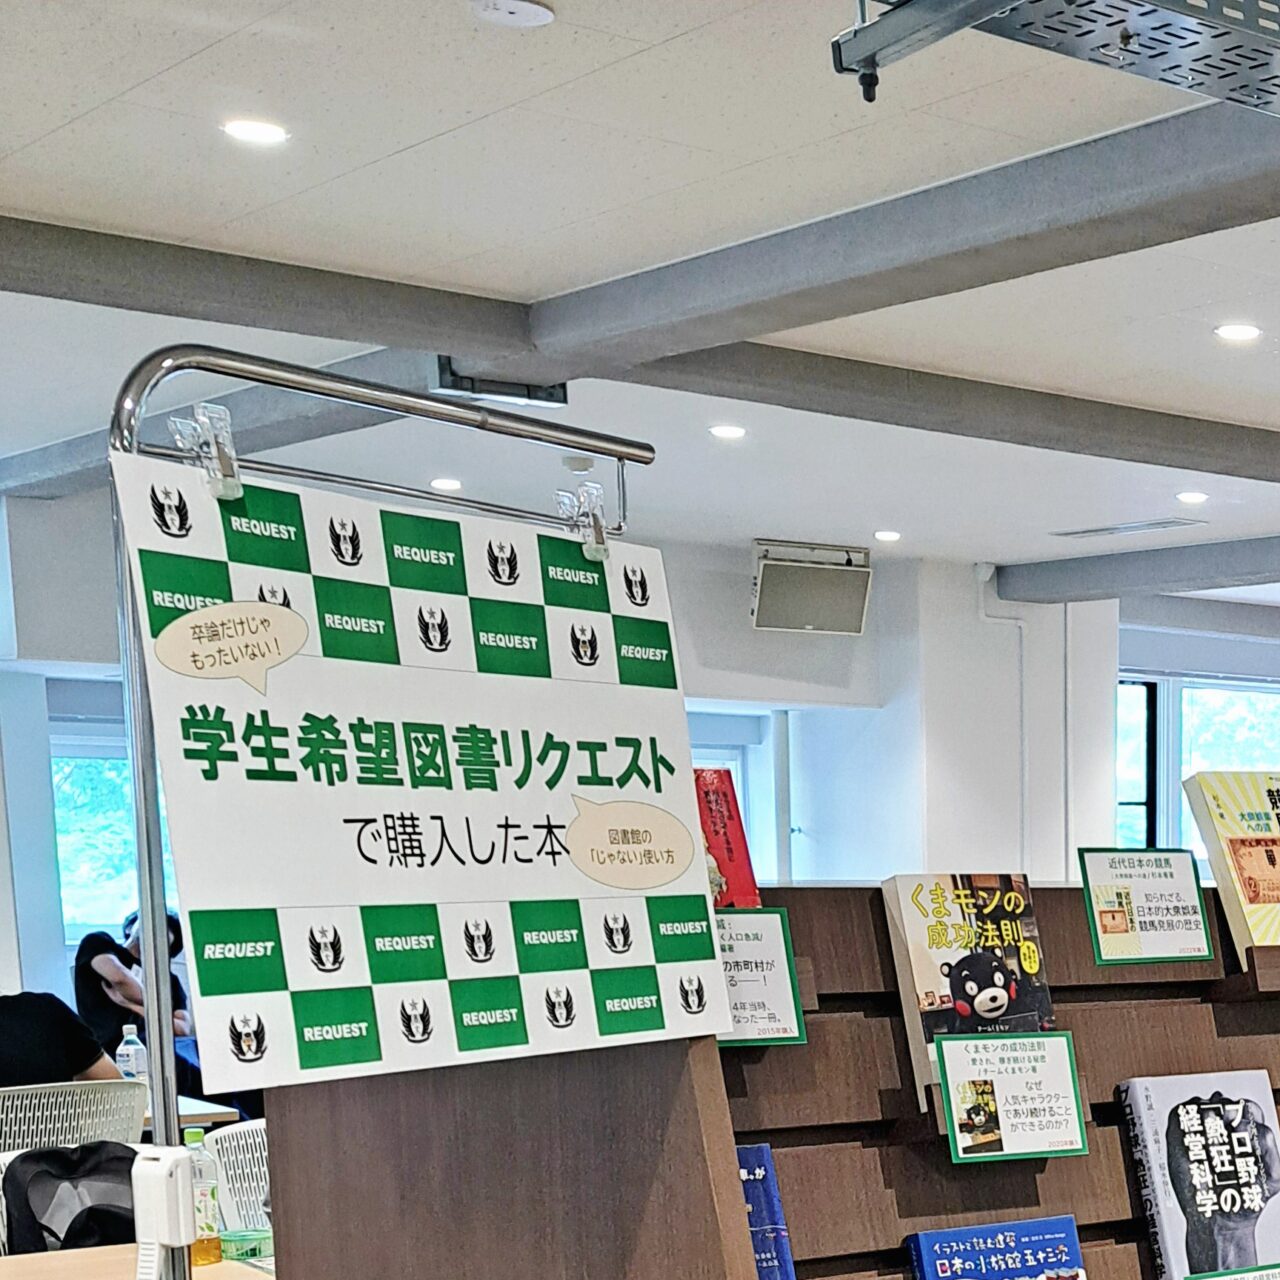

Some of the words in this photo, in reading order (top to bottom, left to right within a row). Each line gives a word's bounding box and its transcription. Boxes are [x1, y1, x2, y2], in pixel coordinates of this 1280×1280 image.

[230, 515, 297, 541] REQUEST
[393, 544, 455, 566] REQUEST
[548, 566, 599, 585] REQUEST
[152, 590, 224, 611] REQUE
[190, 617, 271, 644] 卒論だけじゃ
[324, 613, 385, 634] REQUEST
[479, 632, 537, 650] REQUEST
[190, 638, 281, 671] もったいない！
[620, 645, 668, 662] REQUEST
[180, 704, 675, 793] 学生希望図書リクエスト
[342, 812, 570, 868] で購入した本
[608, 829, 652, 845] 図書館の
[591, 849, 675, 865] 「じゃない」使い方
[1107, 857, 1173, 870] 近代日本の競馬
[911, 882, 1025, 918] くまモンの
[1136, 905, 1200, 918] 日本的大衆娯楽
[659, 920, 708, 936] REQUEST
[927, 919, 1024, 949] 成功法則
[1138, 918, 1202, 932] 競馬発展の歴史
[374, 935, 436, 952] REQUEST
[523, 929, 579, 945] REQUEST
[203, 941, 275, 959] REQUEST
[723, 960, 775, 973] の市町村が
[605, 995, 658, 1012] REQUEST
[462, 1008, 518, 1027] REQUEST
[303, 1022, 369, 1042] REQUEST
[963, 1040, 1046, 1055] くまモンの成功法則
[1025, 1080, 1043, 1091] なぜ
[1003, 1094, 1069, 1106] 人気キャラクター
[1004, 1106, 1072, 1119] であり続けること
[1177, 1104, 1220, 1218] 経営科学
[1201, 1104, 1241, 1215] 「熱狂」の
[1225, 1098, 1265, 1211] プロ野球
[936, 1251, 1022, 1277] 日本の水族館
[1023, 1243, 1070, 1266] 五十三次
